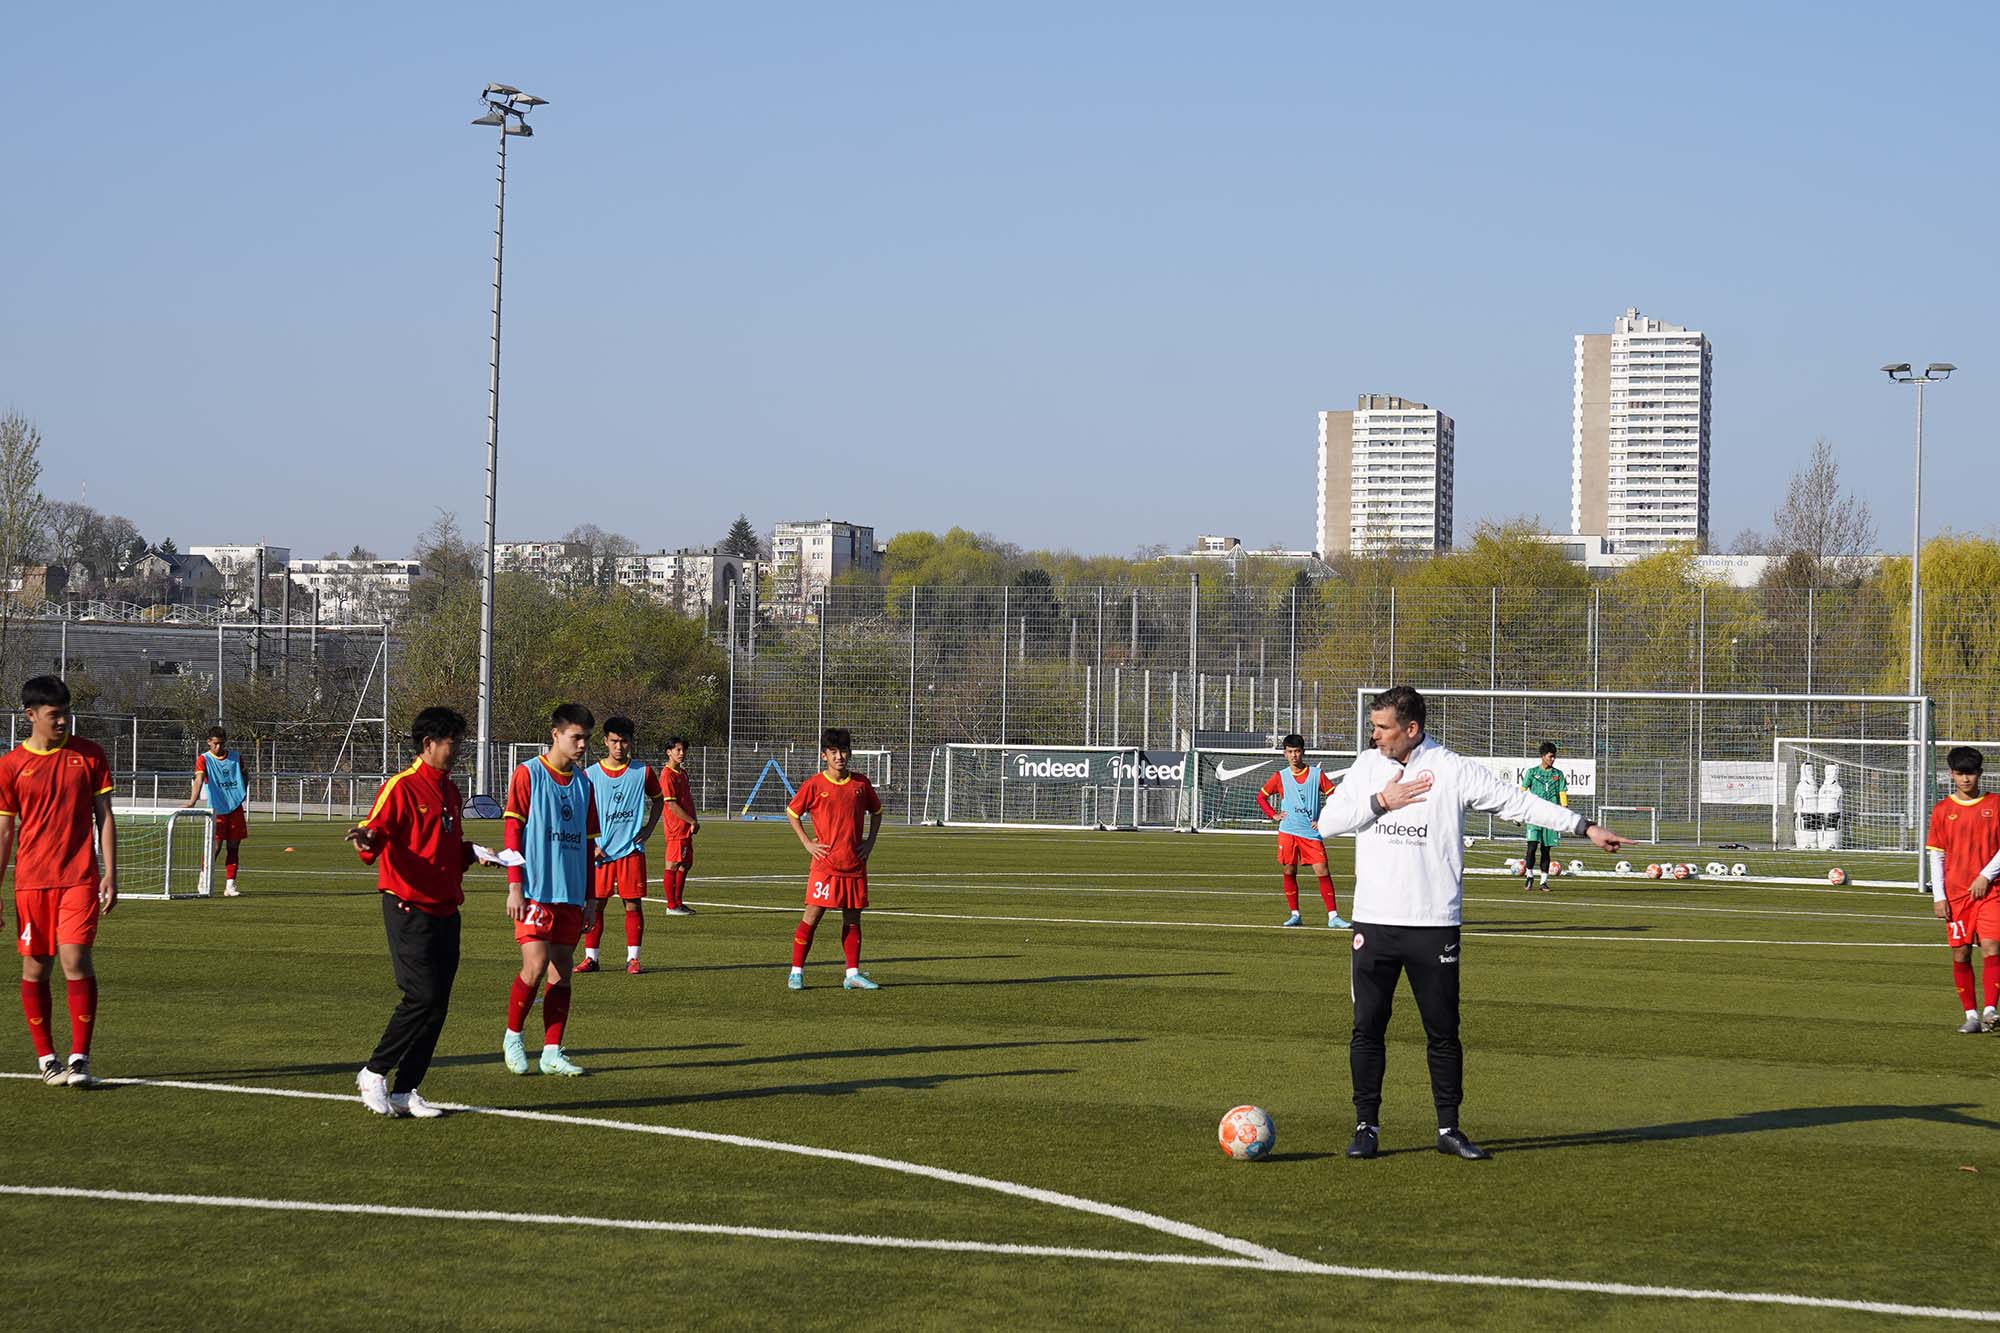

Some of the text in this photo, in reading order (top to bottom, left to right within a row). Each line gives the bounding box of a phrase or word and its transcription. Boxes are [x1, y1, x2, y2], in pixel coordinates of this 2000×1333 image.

[1013, 754, 1089, 778] indeed
[1107, 756, 1185, 781] indeed
[1516, 768, 1591, 786] Kcher
[605, 810, 634, 822] indeed
[547, 829, 582, 844] indeed
[1375, 820, 1428, 838] indeed
[813, 881, 830, 900] 34
[20, 922, 32, 946] 4
[1949, 920, 1967, 939] 21
